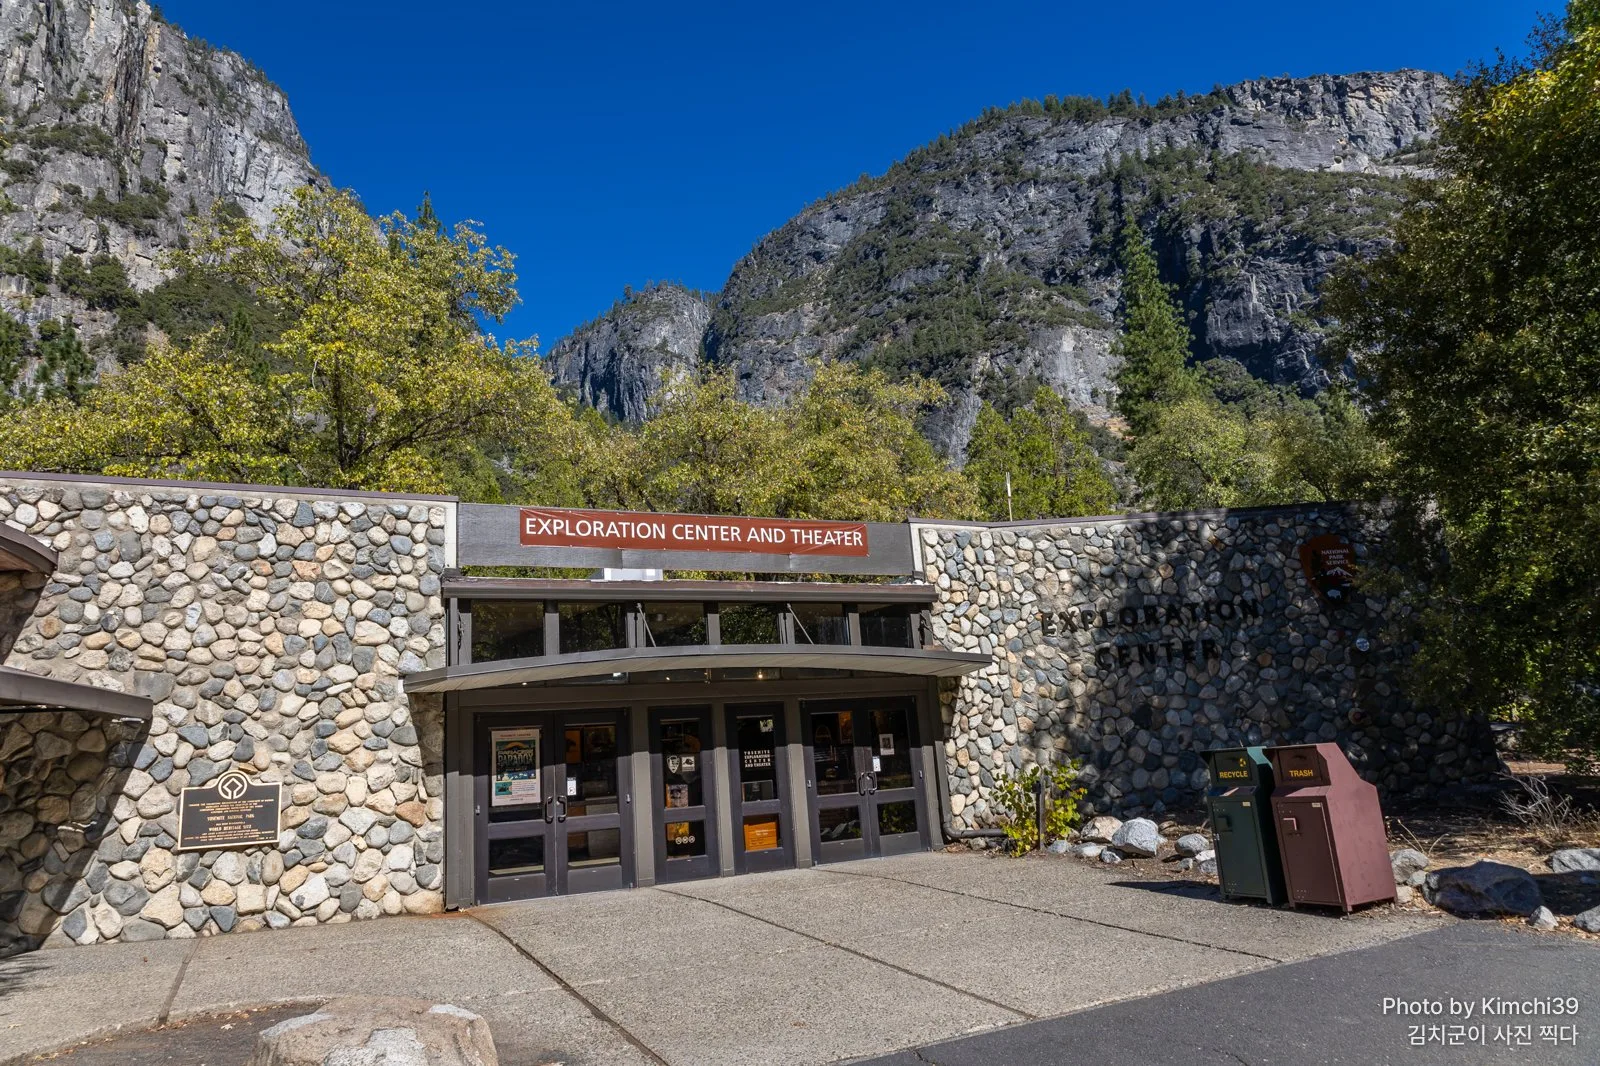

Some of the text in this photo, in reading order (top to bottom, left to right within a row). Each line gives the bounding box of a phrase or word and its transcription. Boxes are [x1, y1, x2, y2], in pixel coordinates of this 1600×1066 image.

[525, 517, 863, 547] EXPLORATION CENTER AND THEATER
[1041, 599, 1260, 636] EXPLORATION
[1096, 639, 1221, 670] CENTER
[1219, 770, 1248, 778] RECYCLE
[1289, 769, 1314, 778] TRASH
